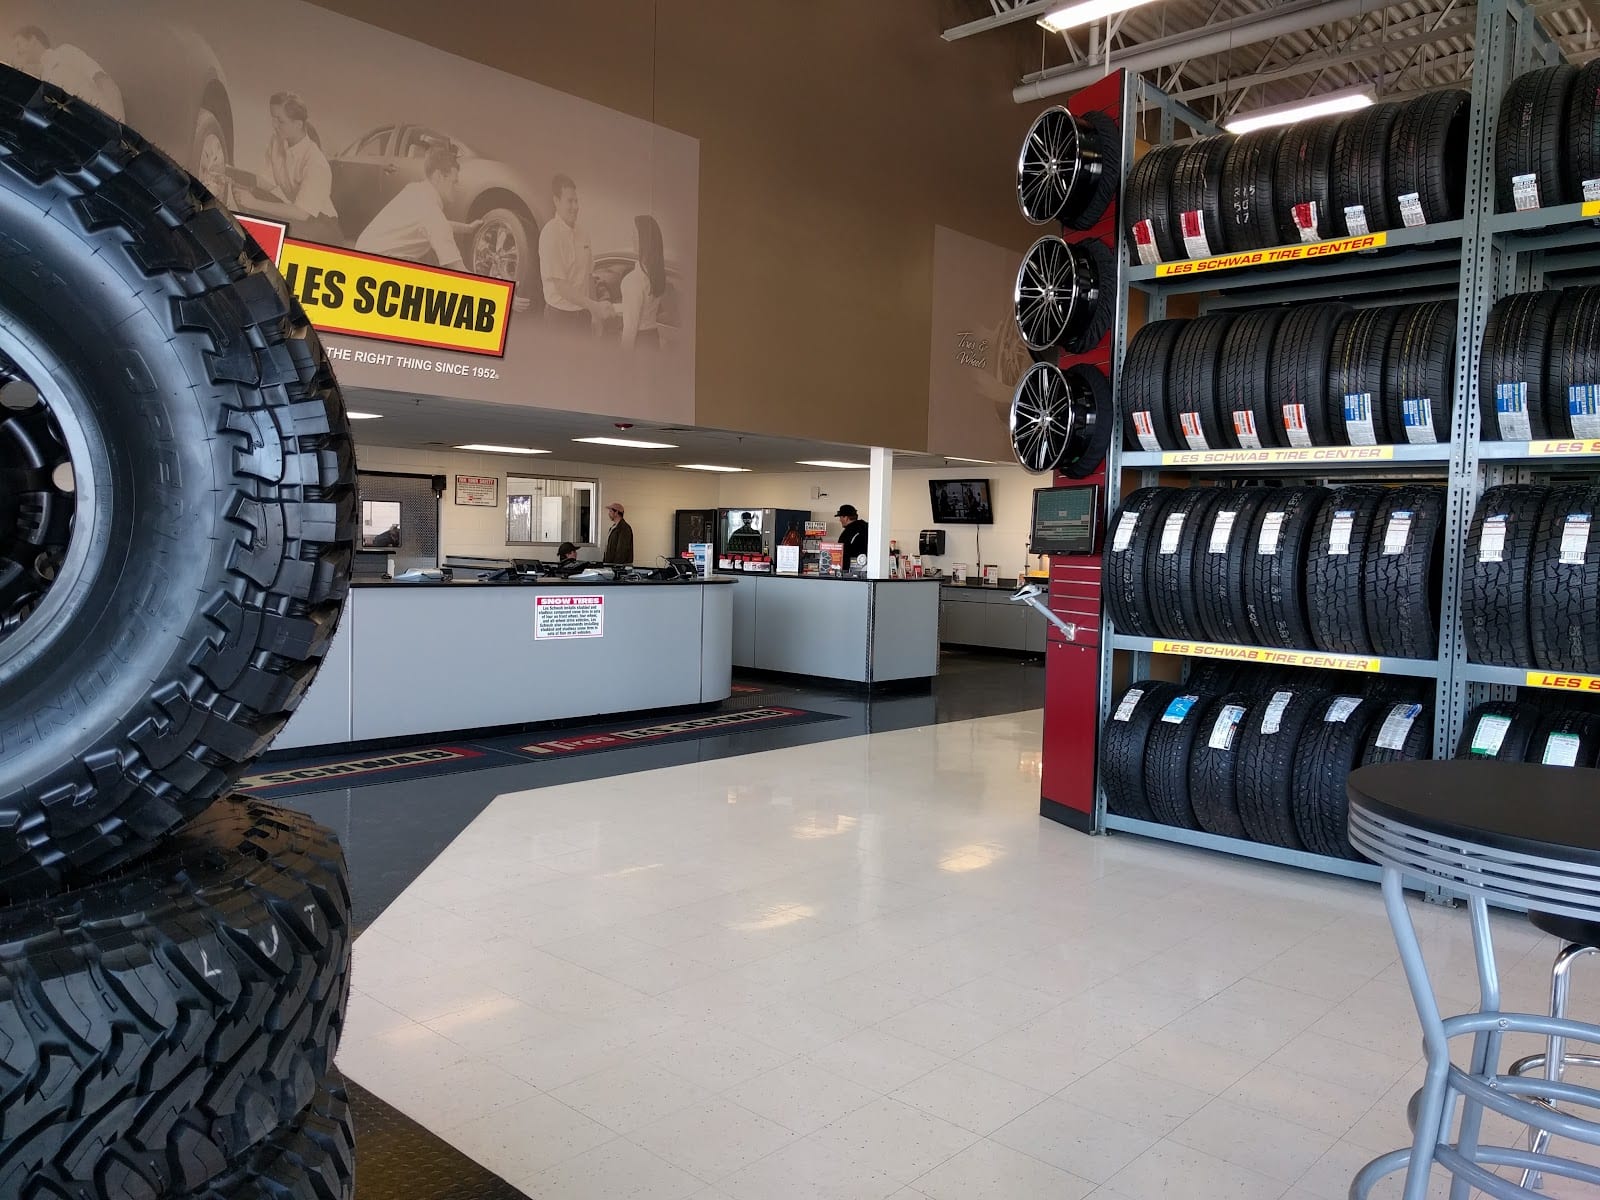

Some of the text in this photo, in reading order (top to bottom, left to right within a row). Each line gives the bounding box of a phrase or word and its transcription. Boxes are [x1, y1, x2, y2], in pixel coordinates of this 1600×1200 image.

[1233, 200, 1249, 211] 50
[1235, 213, 1249, 224] 17
[1166, 236, 1375, 275] LES SCHWAB TIRE CENTER
[285, 263, 497, 333] LES SCHWAB
[326, 347, 352, 361] THE
[354, 351, 394, 366] RIGHT
[396, 357, 432, 371] THING
[435, 362, 469, 376] SINCE
[1173, 449, 1381, 463] LES SCHWAB TIRE CENTER
[1544, 443, 1584, 453] LES
[1163, 643, 1369, 670] LES SCHWAB TIRE CENTER
[1542, 676, 1582, 688] LES
[259, 751, 453, 783] SCHWAB
